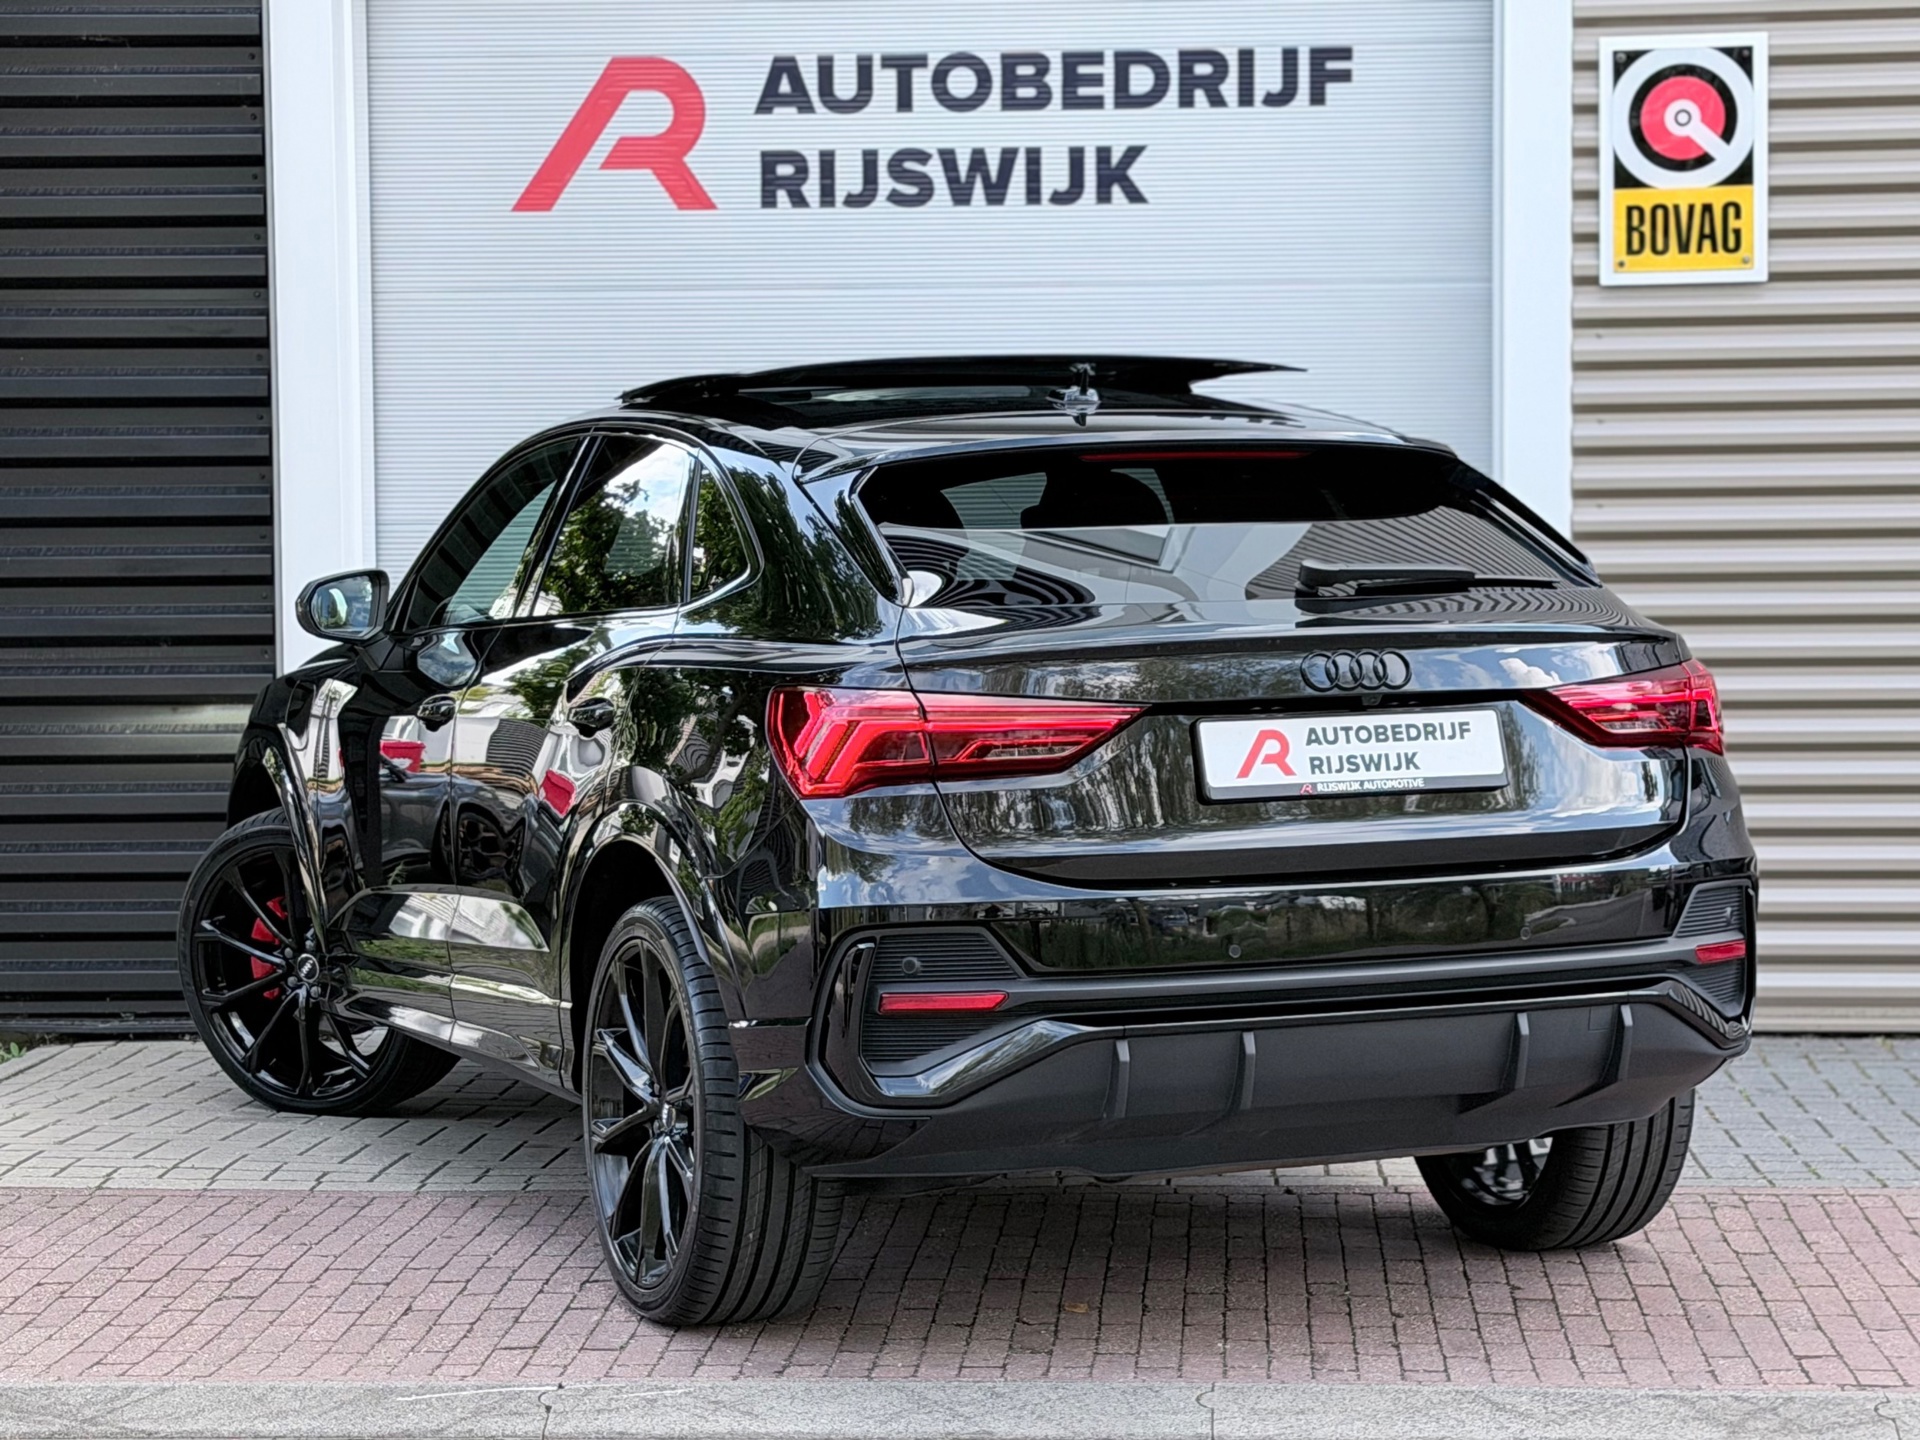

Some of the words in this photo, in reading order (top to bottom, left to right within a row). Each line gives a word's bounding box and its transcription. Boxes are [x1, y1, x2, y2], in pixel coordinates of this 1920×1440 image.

[754, 47, 1353, 115] AUTOBEDRIJF
[760, 146, 1149, 209] RIJSWIJK
[1626, 201, 1742, 256] BOVAG
[1305, 721, 1471, 746] AUTOBEDRIJF
[1309, 751, 1421, 775] RIJSWIJK
[1316, 780, 1361, 792] RIJSWIJK
[1363, 778, 1425, 790] AUTOMOTIVE
